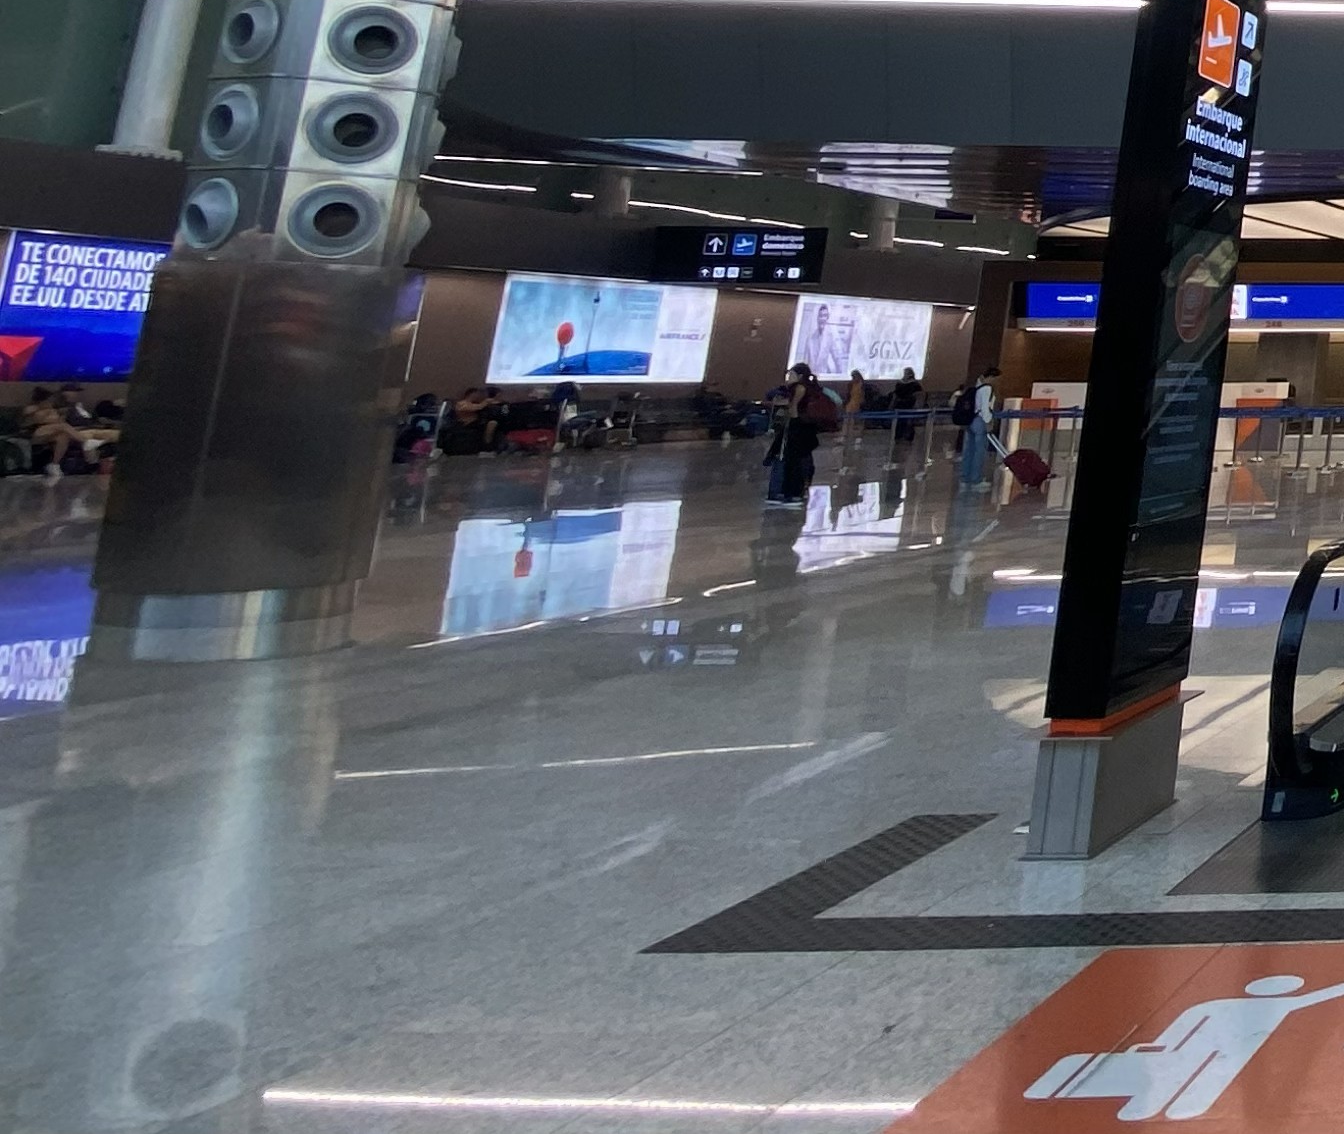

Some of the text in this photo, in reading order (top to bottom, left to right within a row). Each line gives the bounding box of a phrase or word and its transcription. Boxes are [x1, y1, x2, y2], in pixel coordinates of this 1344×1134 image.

[1196, 95, 1243, 132] Embarque
[1186, 118, 1247, 158] internacional
[1192, 153, 1235, 179] International
[1188, 169, 1234, 197] boarding area
[21, 241, 46, 263] TE
[14, 263, 155, 292] DE 140 CIUDADE
[9, 284, 67, 308] EE.UU.
[69, 288, 129, 311] DESDE
